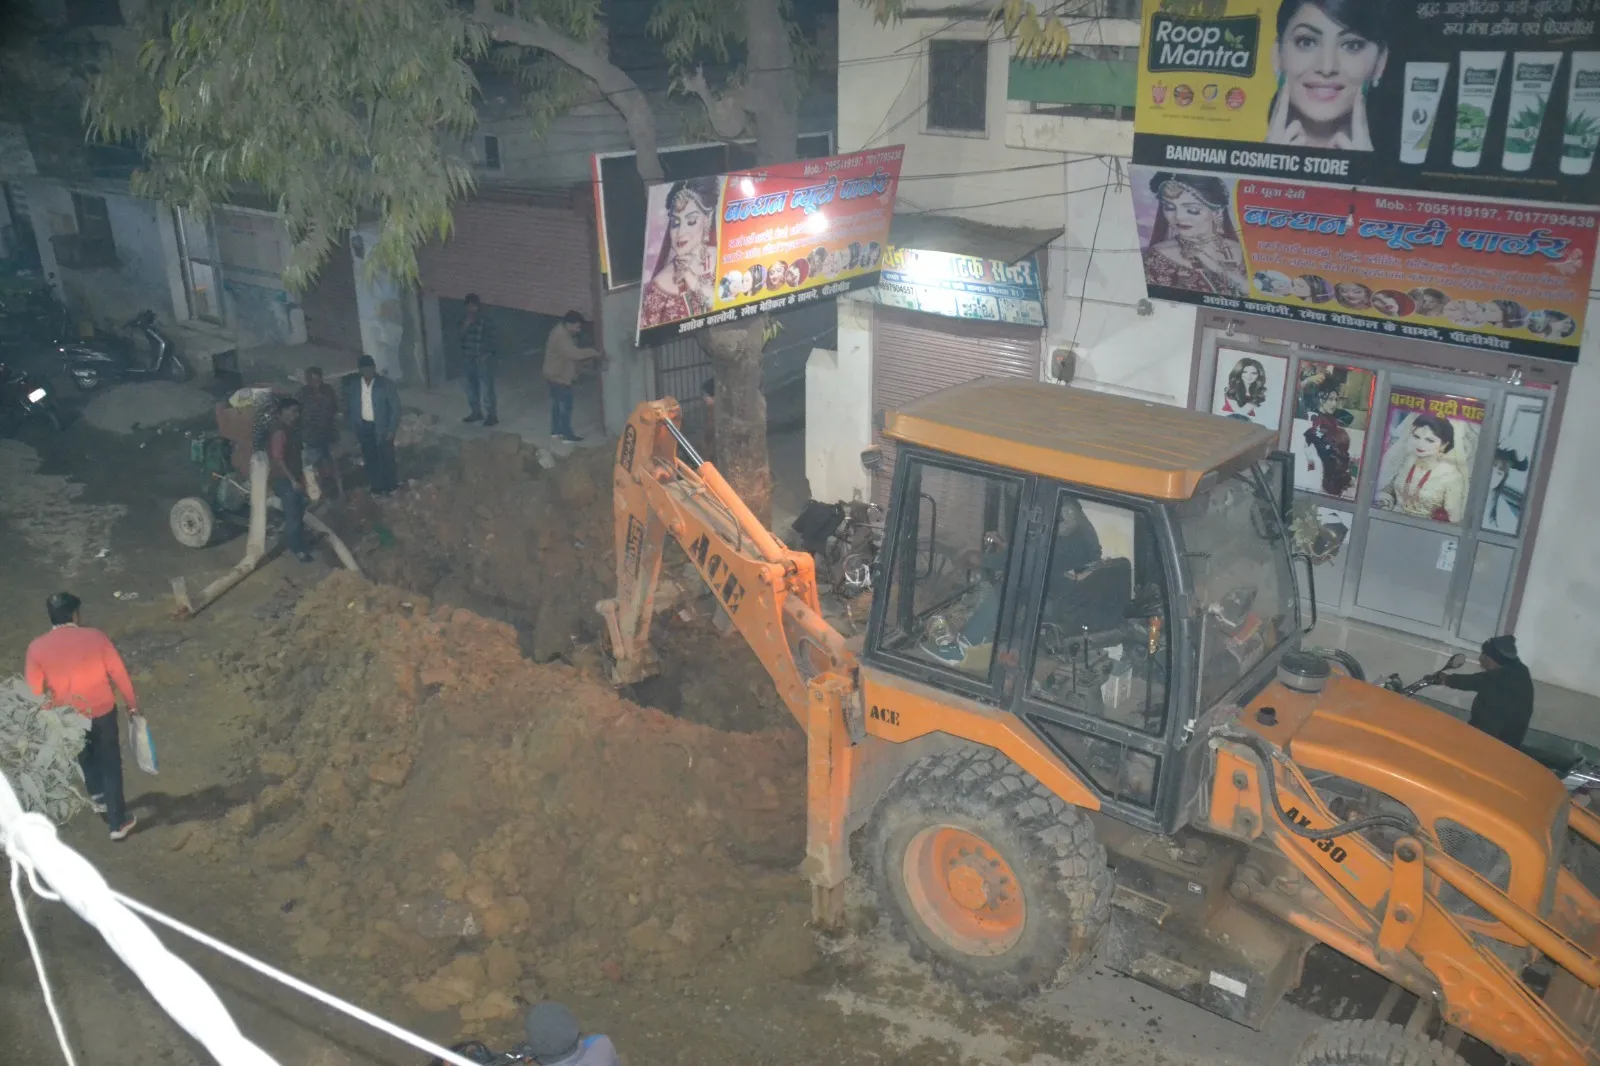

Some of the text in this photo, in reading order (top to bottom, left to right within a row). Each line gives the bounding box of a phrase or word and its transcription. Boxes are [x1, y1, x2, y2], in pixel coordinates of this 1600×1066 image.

[1156, 20, 1220, 48] Roop
[1159, 43, 1250, 68] Mantra
[1166, 144, 1350, 176] BANDHAN COSMETIC STORE
[1243, 205, 1571, 259] बन्धन ब्यूटी पार्लर
[688, 531, 745, 614] ACE
[870, 705, 900, 727] ACE
